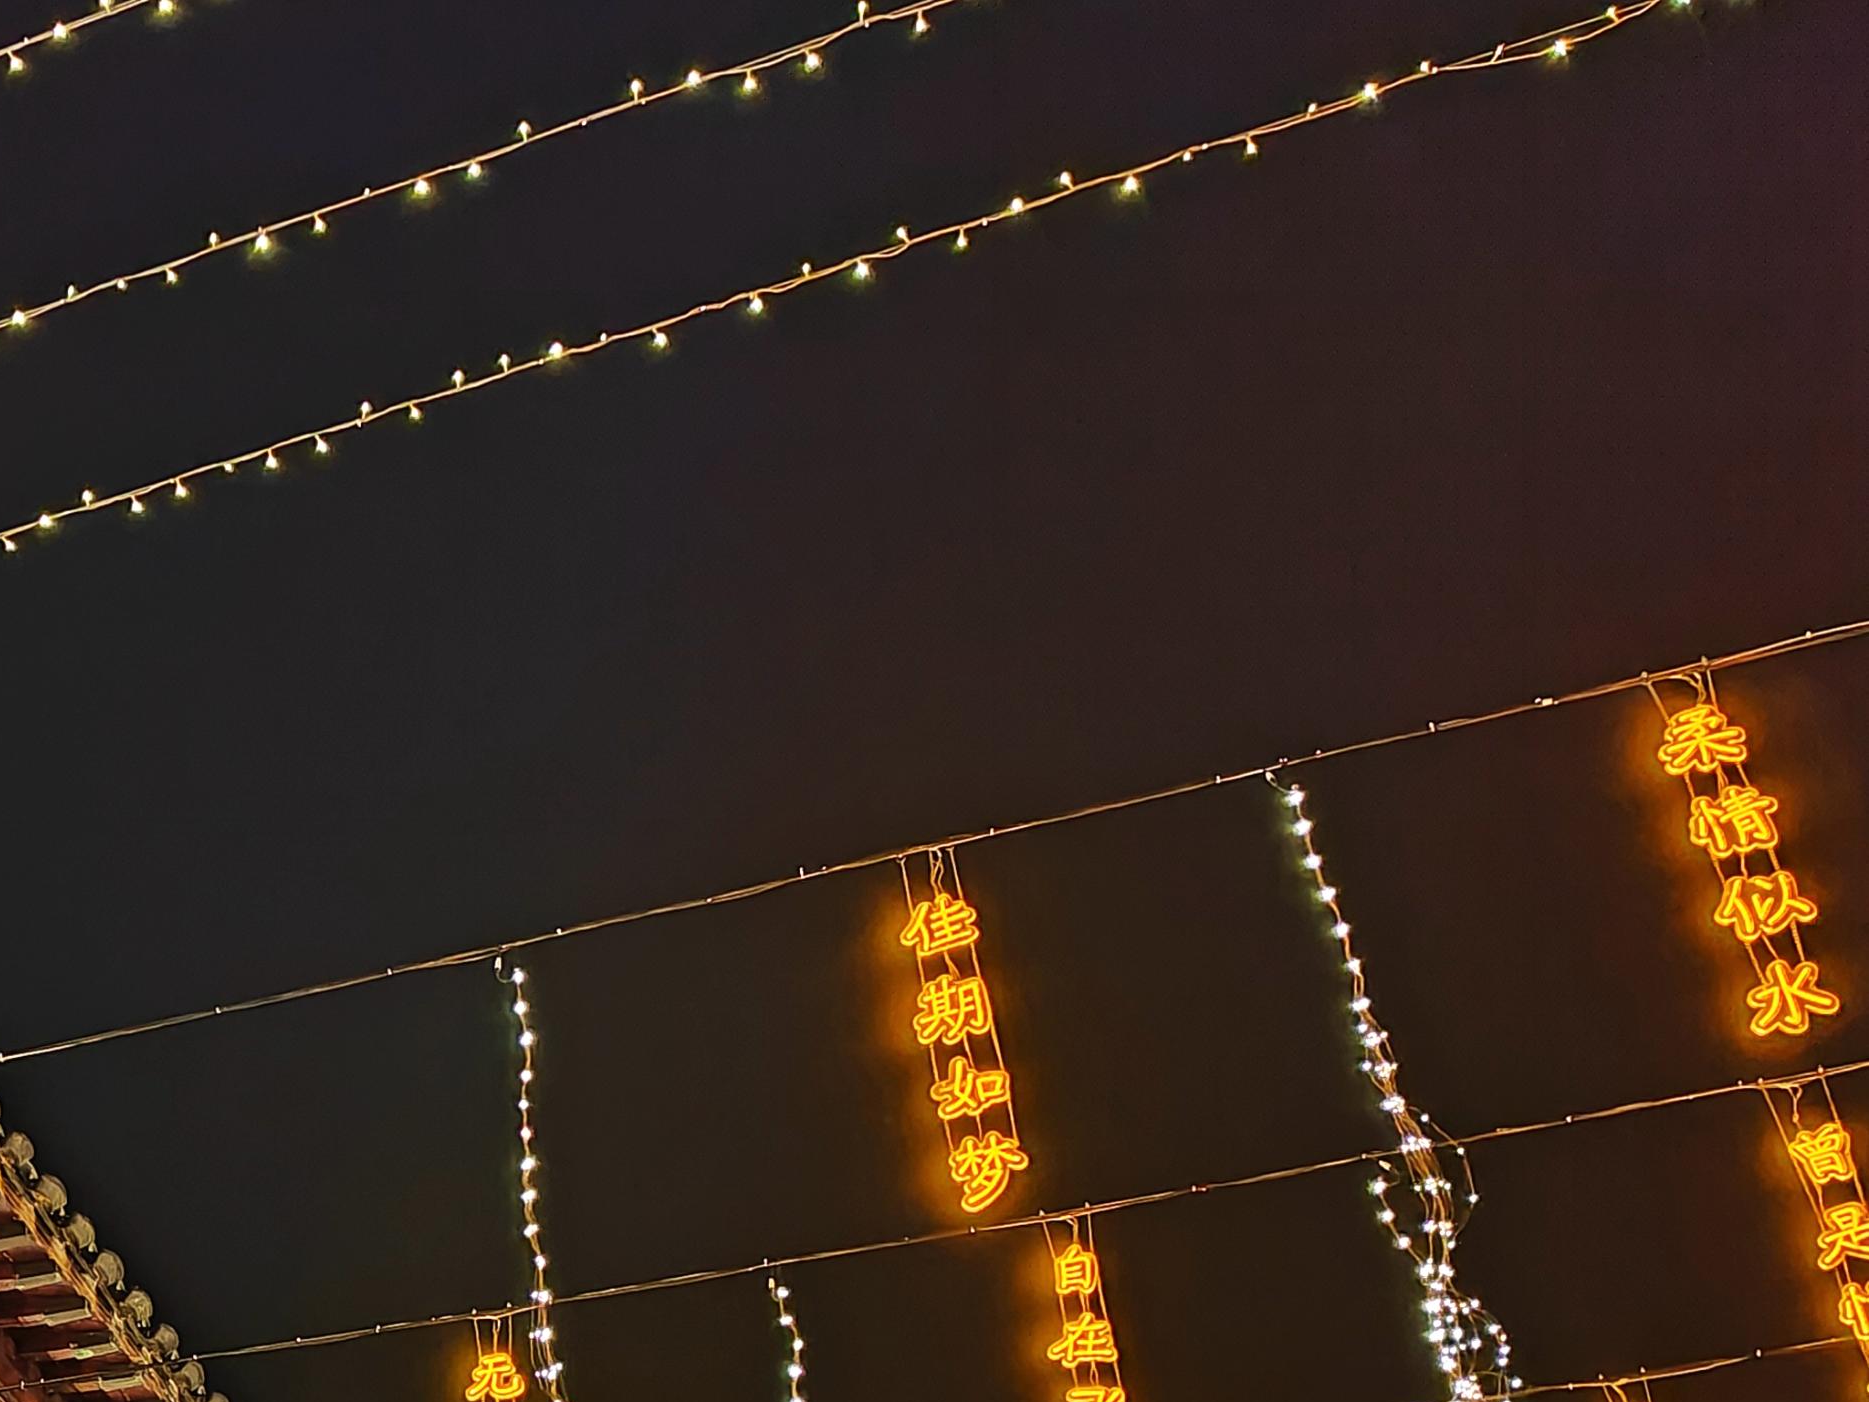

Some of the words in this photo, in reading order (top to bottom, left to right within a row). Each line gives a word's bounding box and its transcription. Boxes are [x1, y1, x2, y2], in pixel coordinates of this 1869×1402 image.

[1658, 704, 1839, 1037] 柔情似水
[900, 892, 1029, 1214] 佳期如梦
